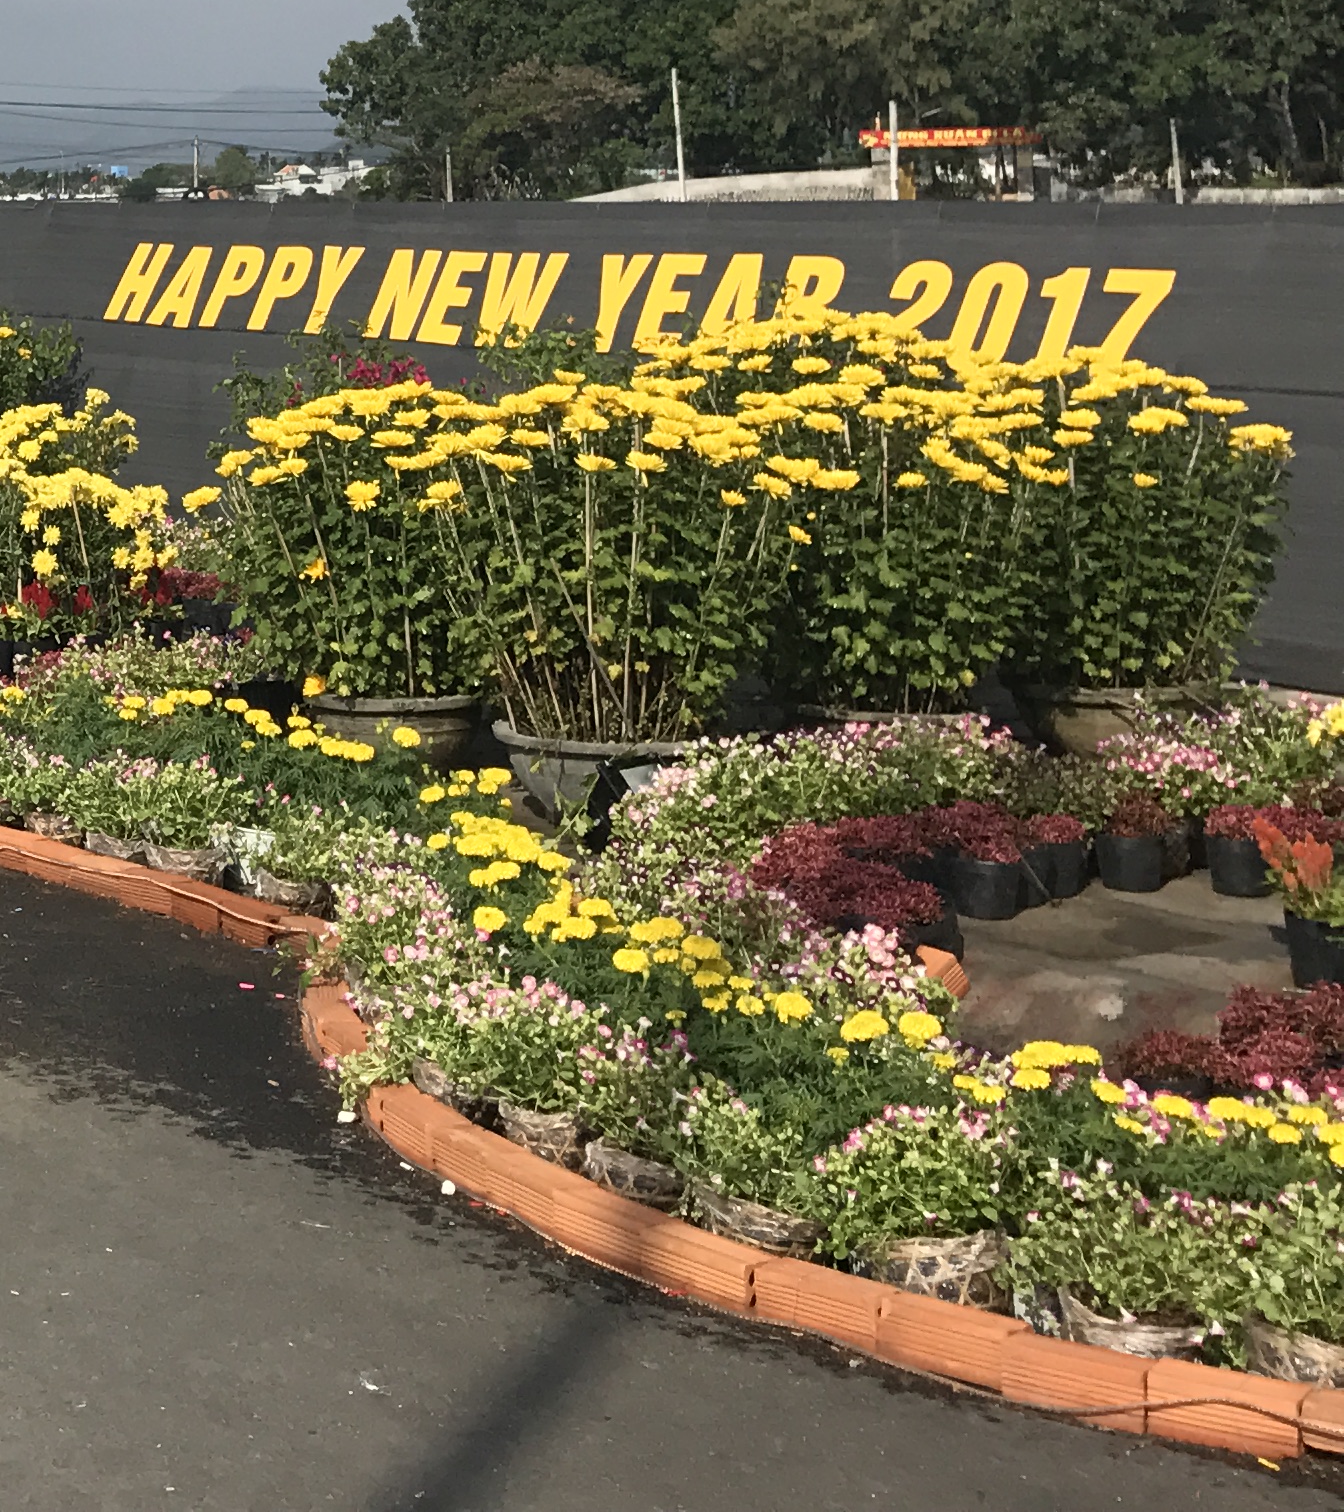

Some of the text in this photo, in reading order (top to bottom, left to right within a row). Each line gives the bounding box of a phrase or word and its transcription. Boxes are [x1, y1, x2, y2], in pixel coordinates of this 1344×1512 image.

[103, 242, 1177, 370] HAPPY NEW YEAR 2017
